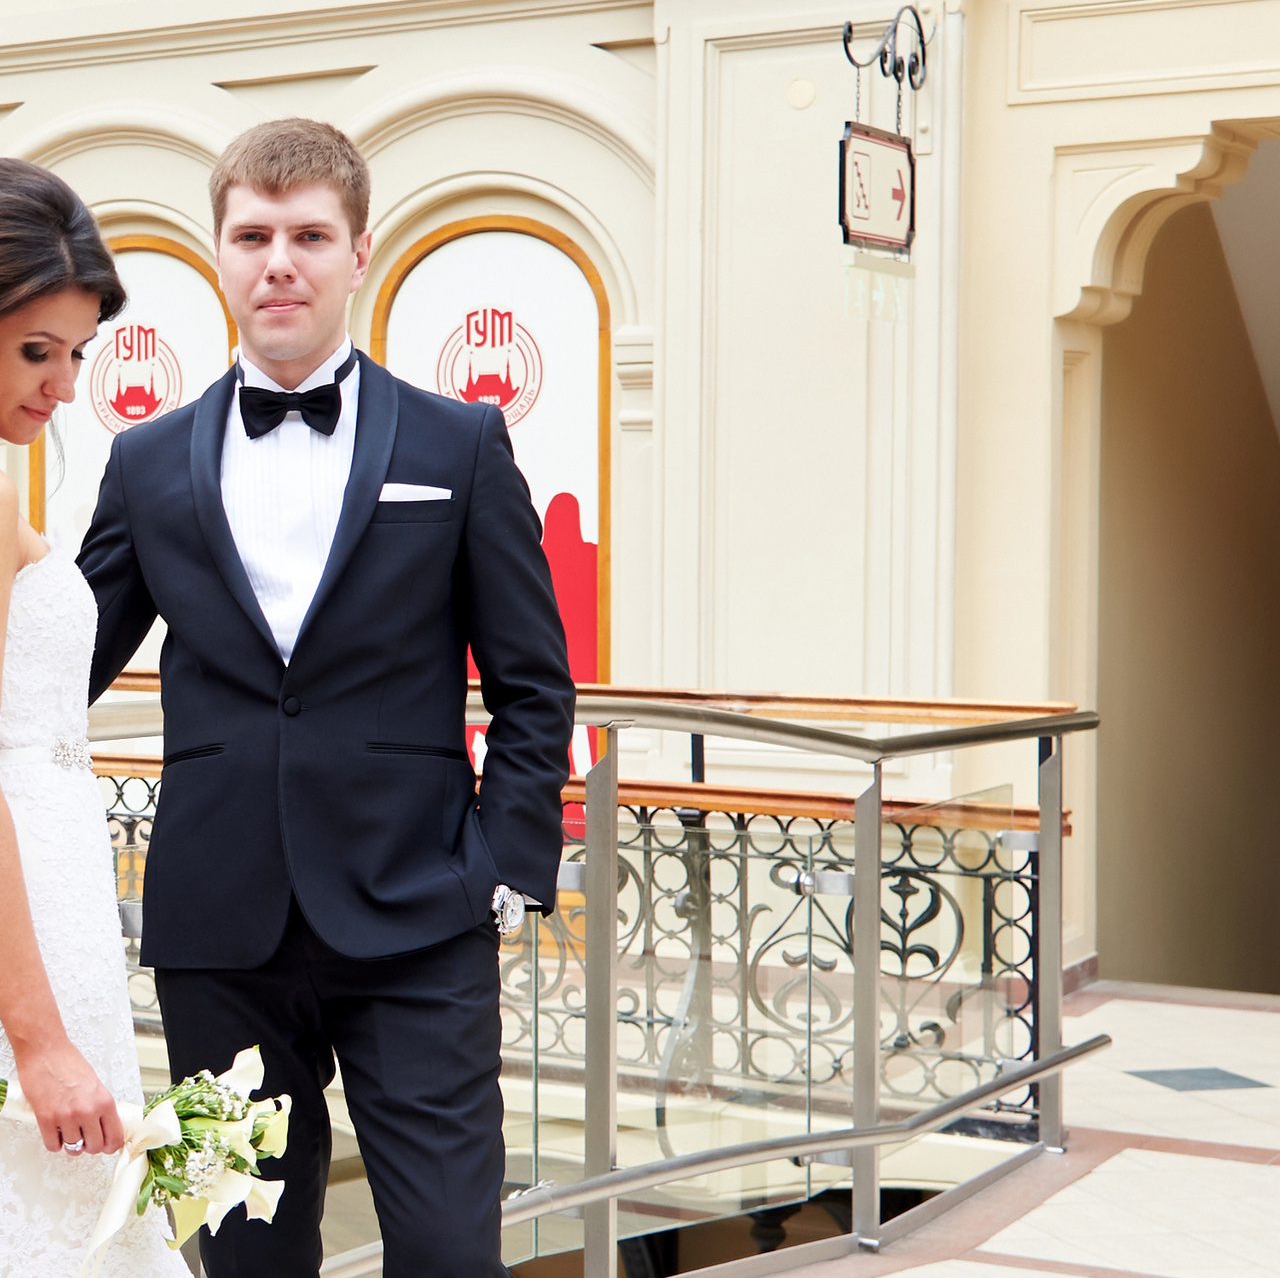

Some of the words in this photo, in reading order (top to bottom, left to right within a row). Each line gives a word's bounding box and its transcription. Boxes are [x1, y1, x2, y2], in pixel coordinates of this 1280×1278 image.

[116, 325, 156, 362] ГУМ
[466, 308, 513, 348] ГУМ
[125, 404, 147, 416] 1893
[505, 389, 535, 422] ОЩАДЬ
